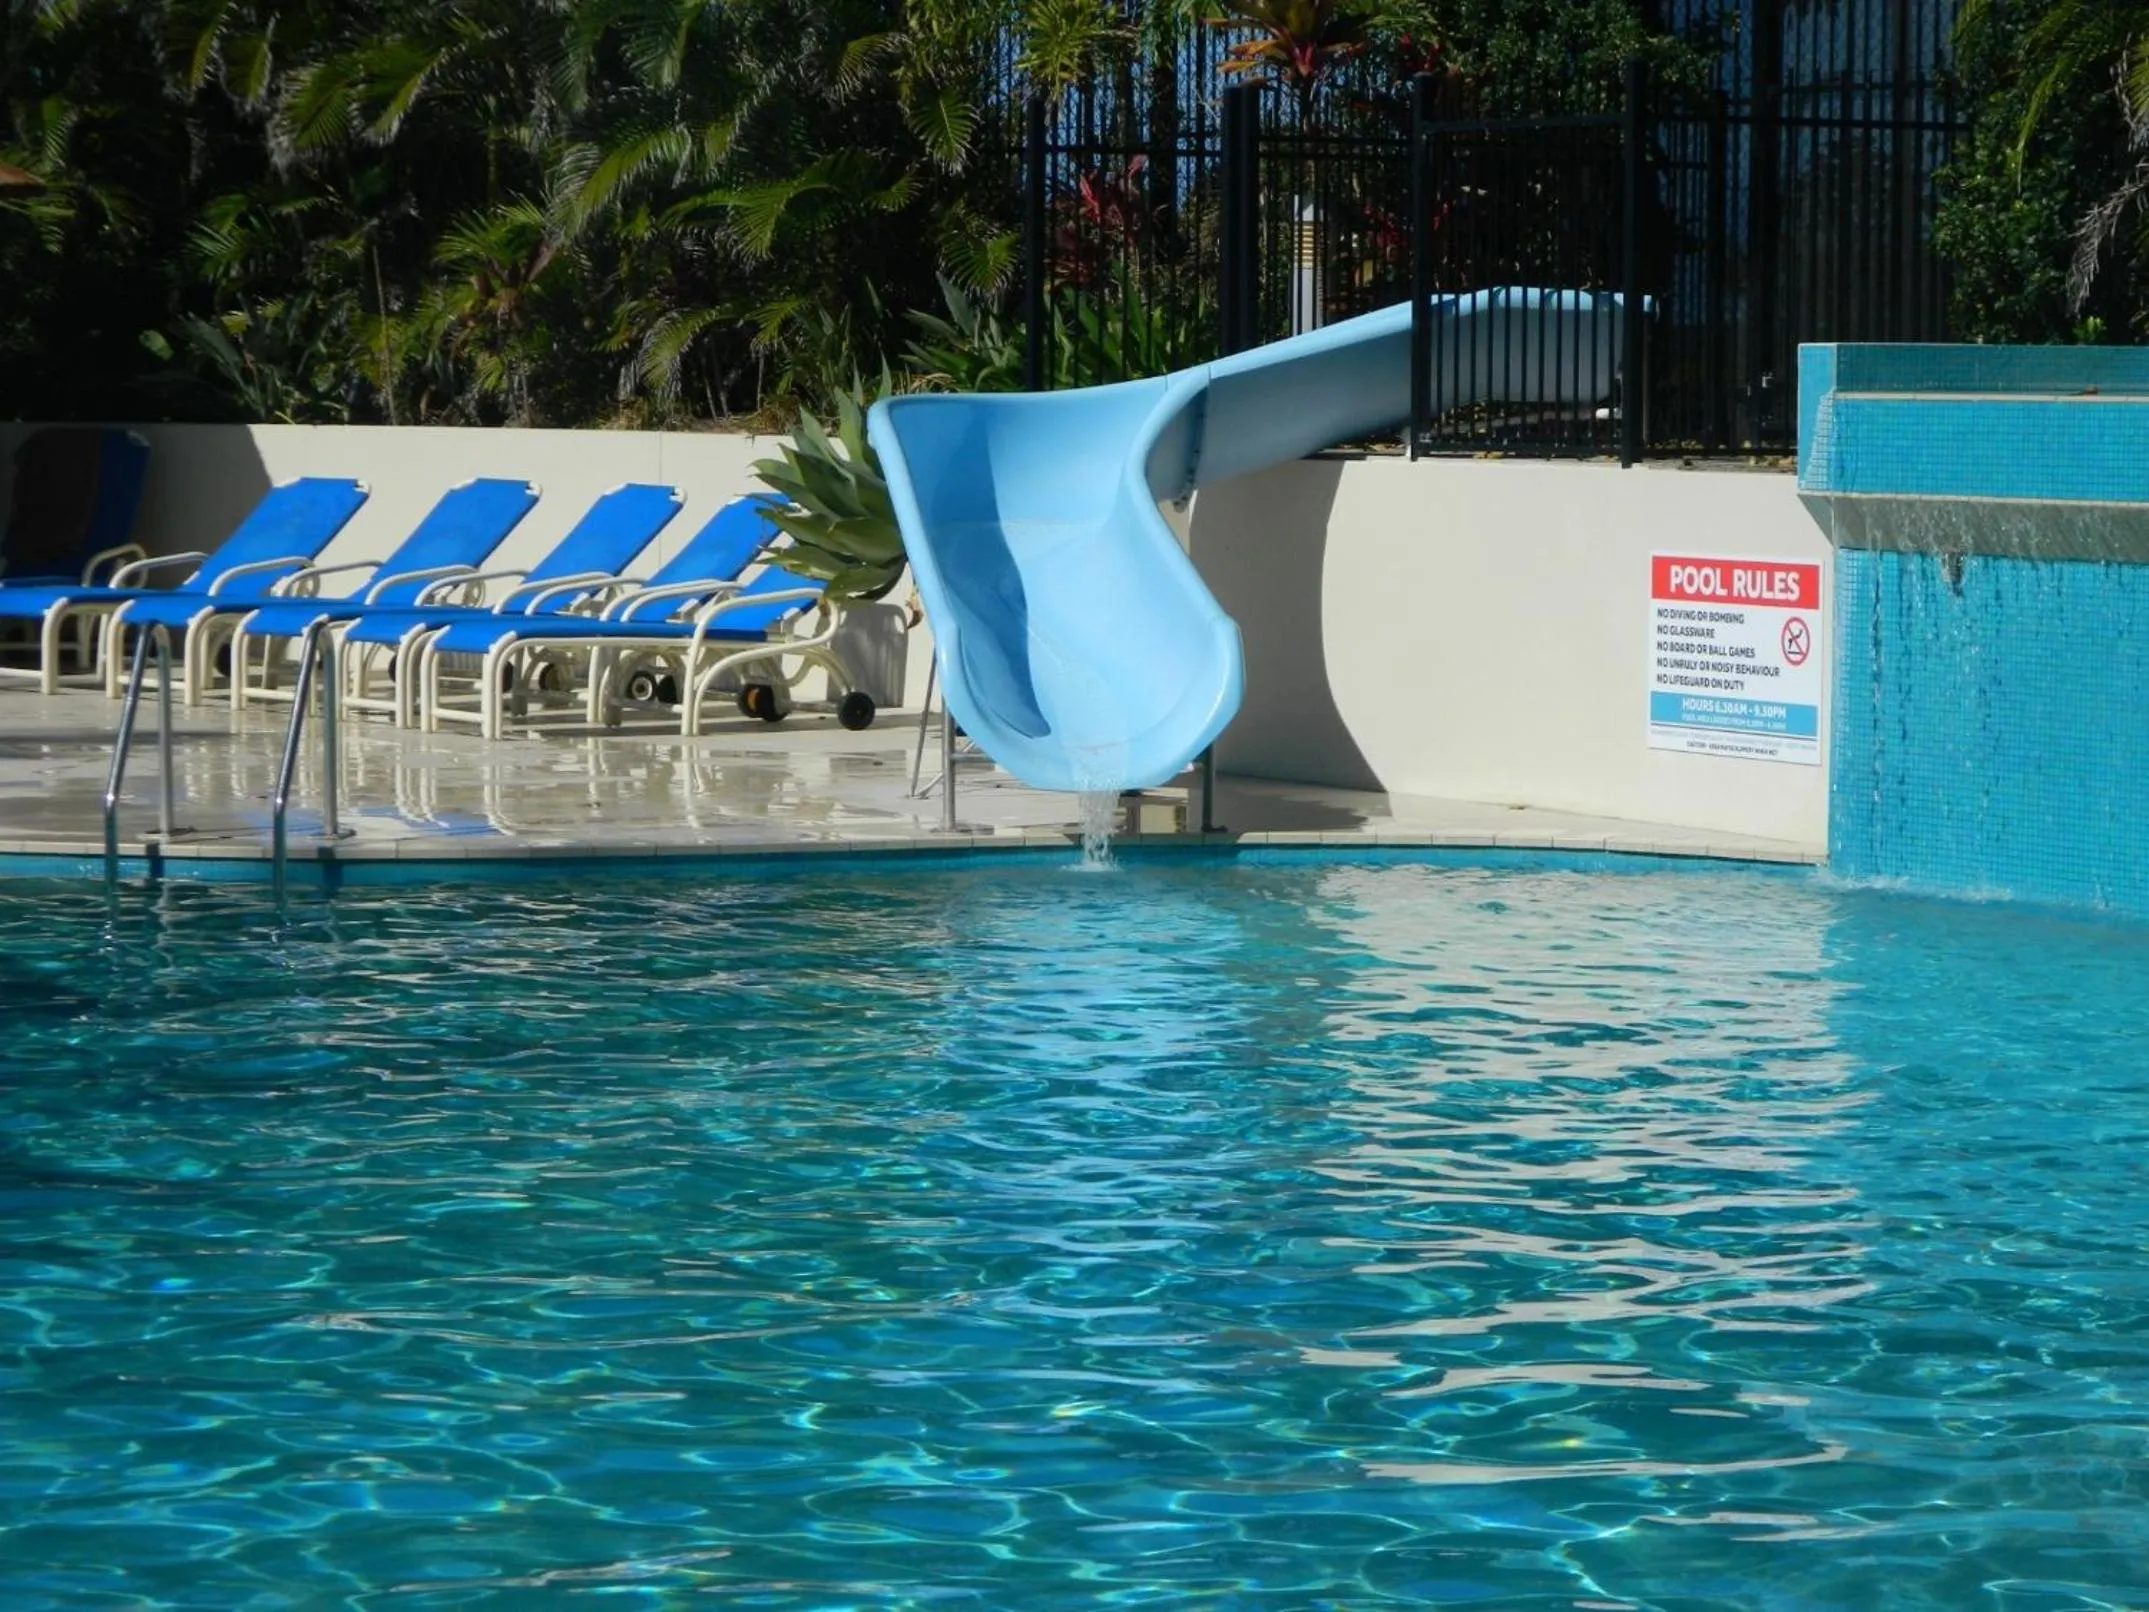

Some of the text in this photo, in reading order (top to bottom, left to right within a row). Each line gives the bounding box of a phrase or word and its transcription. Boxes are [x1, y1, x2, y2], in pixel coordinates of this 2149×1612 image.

[1669, 564, 1800, 601] POOL RULES
[1657, 608, 1744, 624] NO DIVING OR BOMBING
[1657, 625, 1715, 639] NO GLASSWARE
[1657, 641, 1756, 659] NO BOARD OR BALL GAMES
[1657, 657, 1780, 677] NO UNRULY OR NOISY BEHAVIOUR
[1657, 674, 1744, 691] NO LIFEGUARD ON DUTY
[1682, 696, 1714, 713] HOURS
